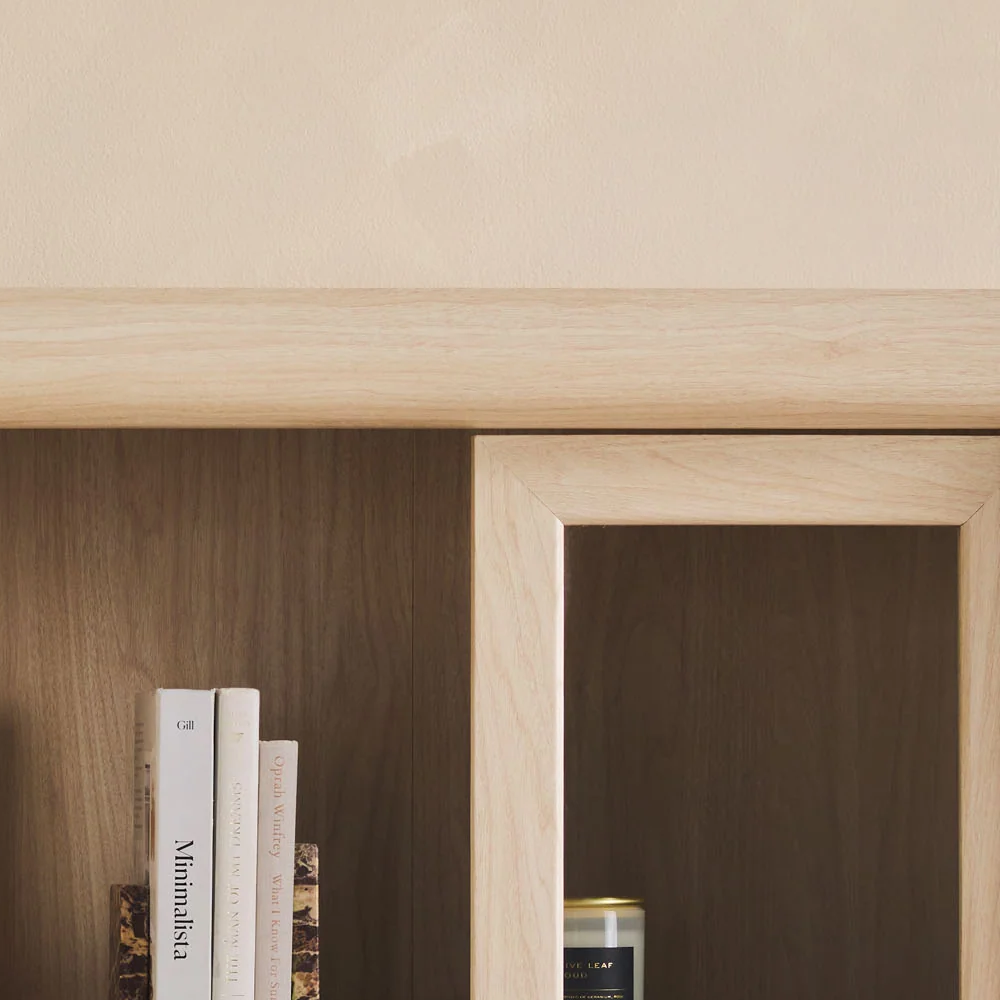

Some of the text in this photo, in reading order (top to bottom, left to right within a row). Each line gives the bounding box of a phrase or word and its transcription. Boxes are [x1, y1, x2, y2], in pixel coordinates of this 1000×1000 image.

[176, 720, 195, 731] Gill
[268, 755, 286, 859] Oprah Winfrey
[173, 839, 195, 961] Minimalista
[271, 874, 283, 905] What
[269, 919, 281, 953] Know
